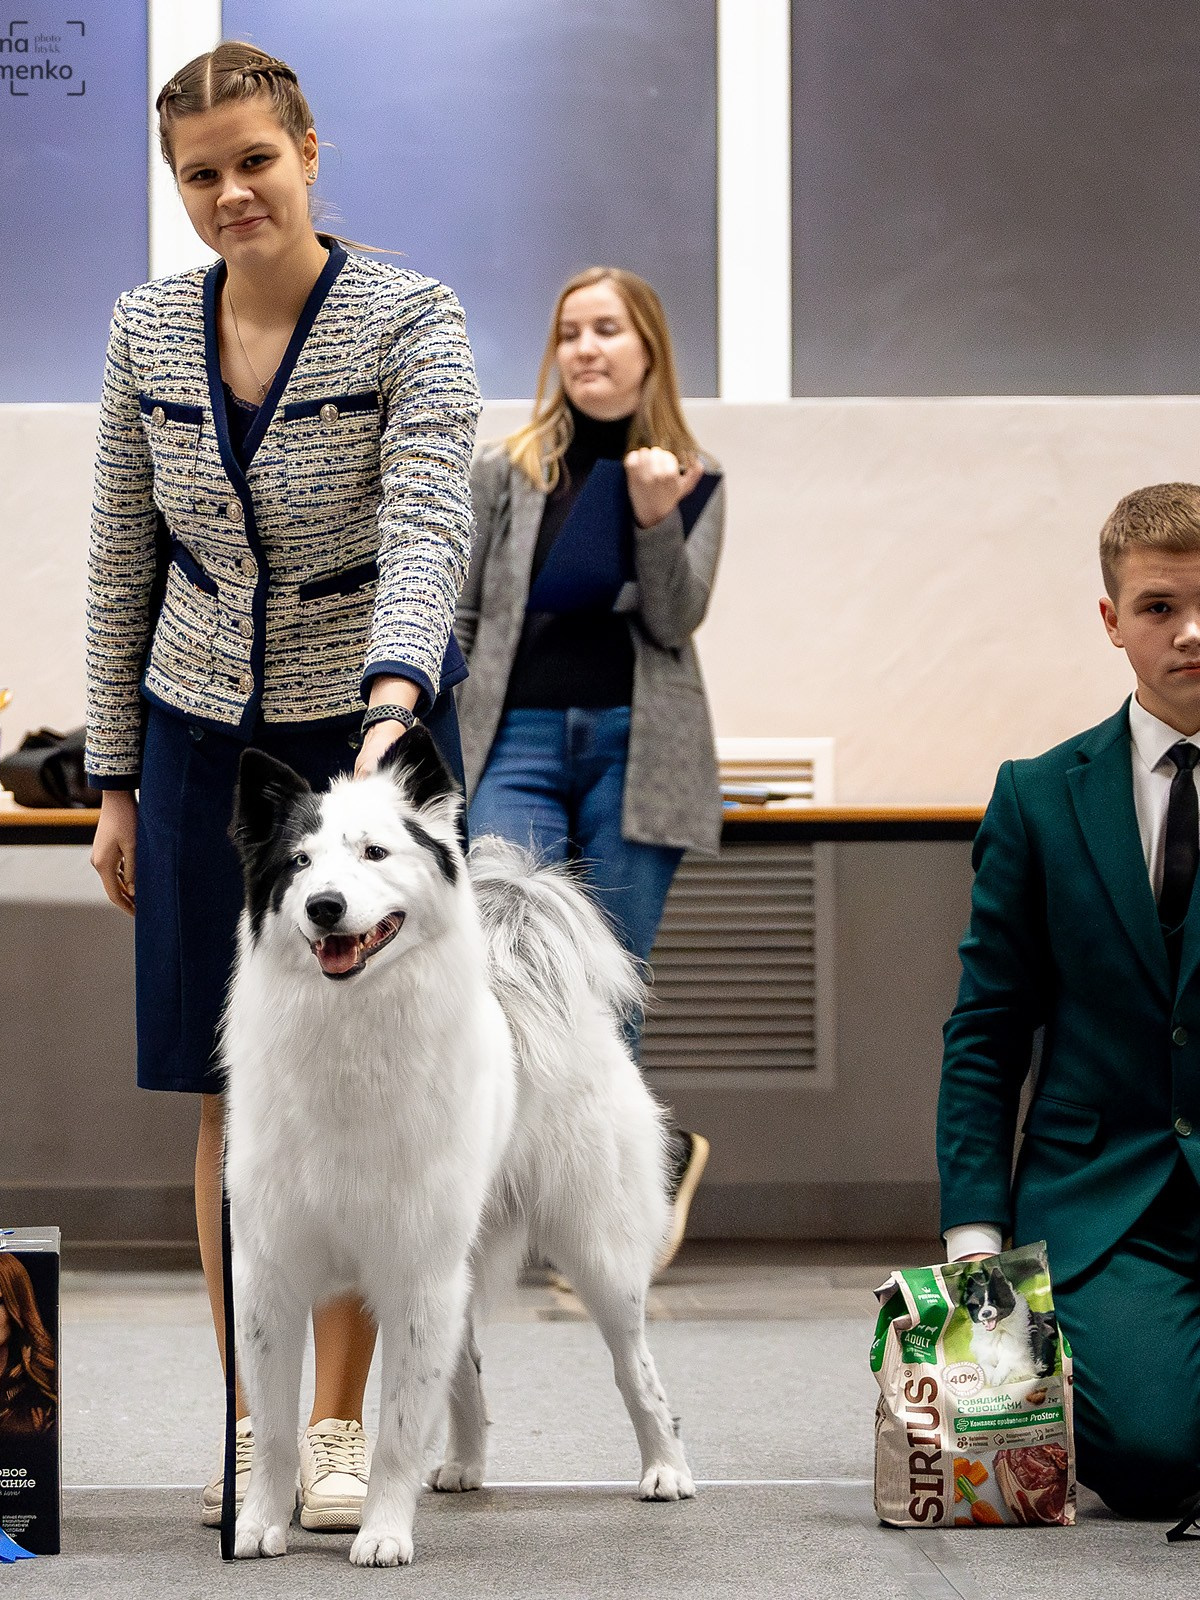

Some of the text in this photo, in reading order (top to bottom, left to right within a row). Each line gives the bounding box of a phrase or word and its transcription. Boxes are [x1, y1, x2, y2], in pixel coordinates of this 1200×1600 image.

[905, 1332, 931, 1348] ADULT
[950, 1372, 978, 1385] 40%
[957, 1394, 1012, 1406] ГОВЯДИНА
[967, 1401, 1023, 1413] ОВОЩАМИ
[904, 1377, 944, 1523] SIRIUS
